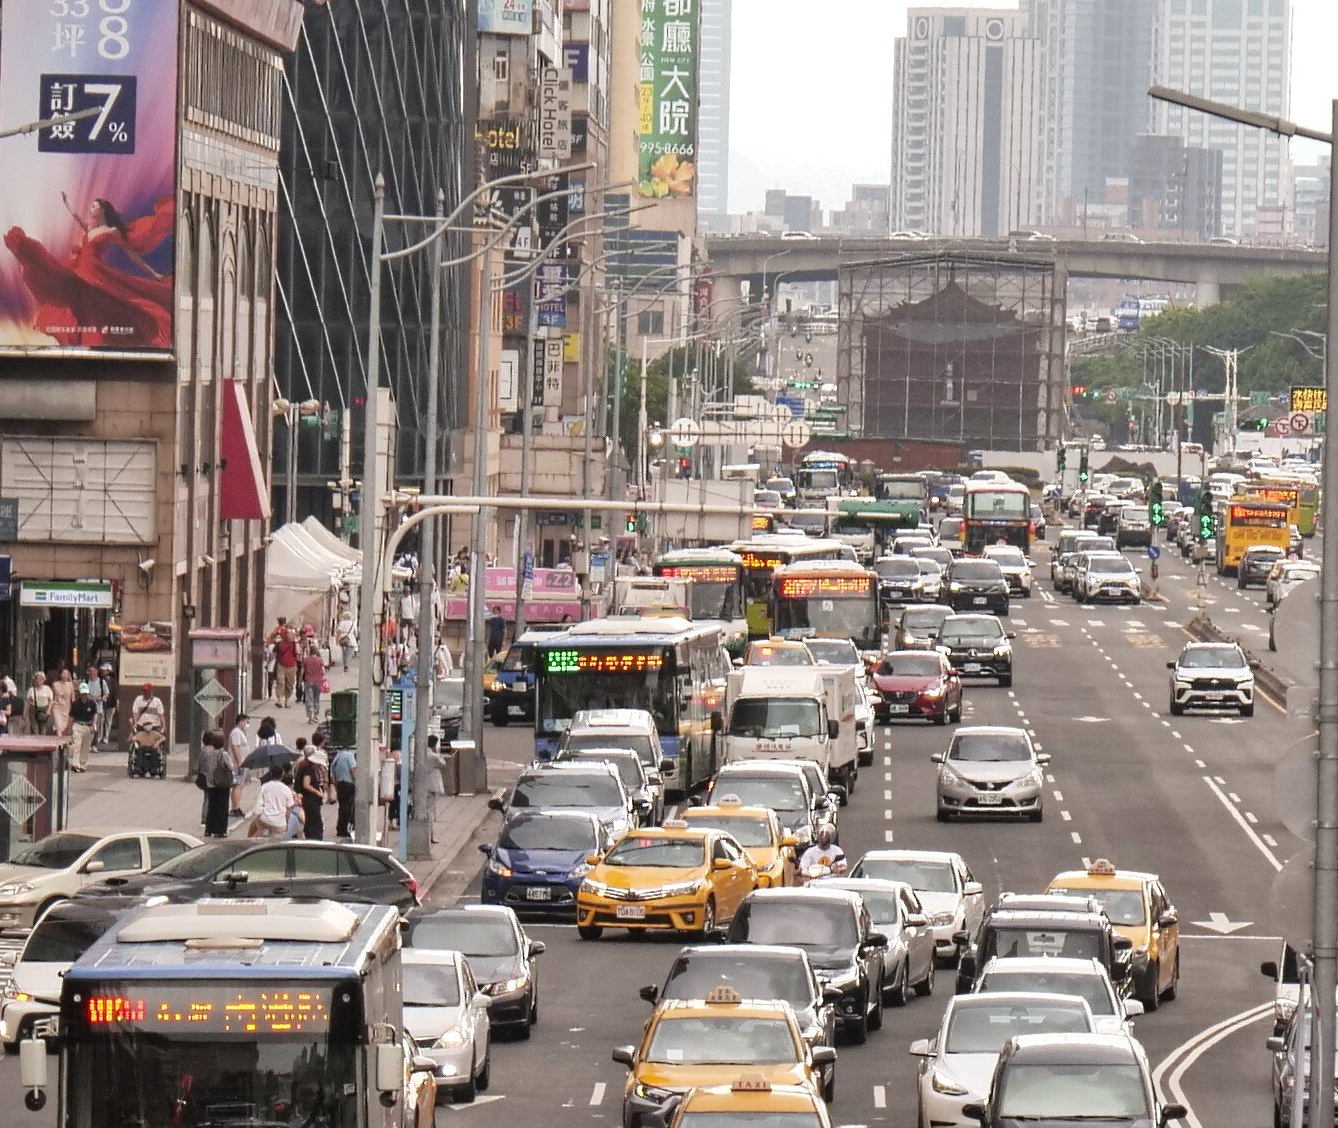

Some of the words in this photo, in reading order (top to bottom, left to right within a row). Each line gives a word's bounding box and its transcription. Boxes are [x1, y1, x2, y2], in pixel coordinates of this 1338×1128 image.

[543, 68, 559, 105] Click
[542, 109, 558, 151] Hotel
[49, 591, 99, 604] FamilyMart
[739, 1081, 767, 1089] TAXI
